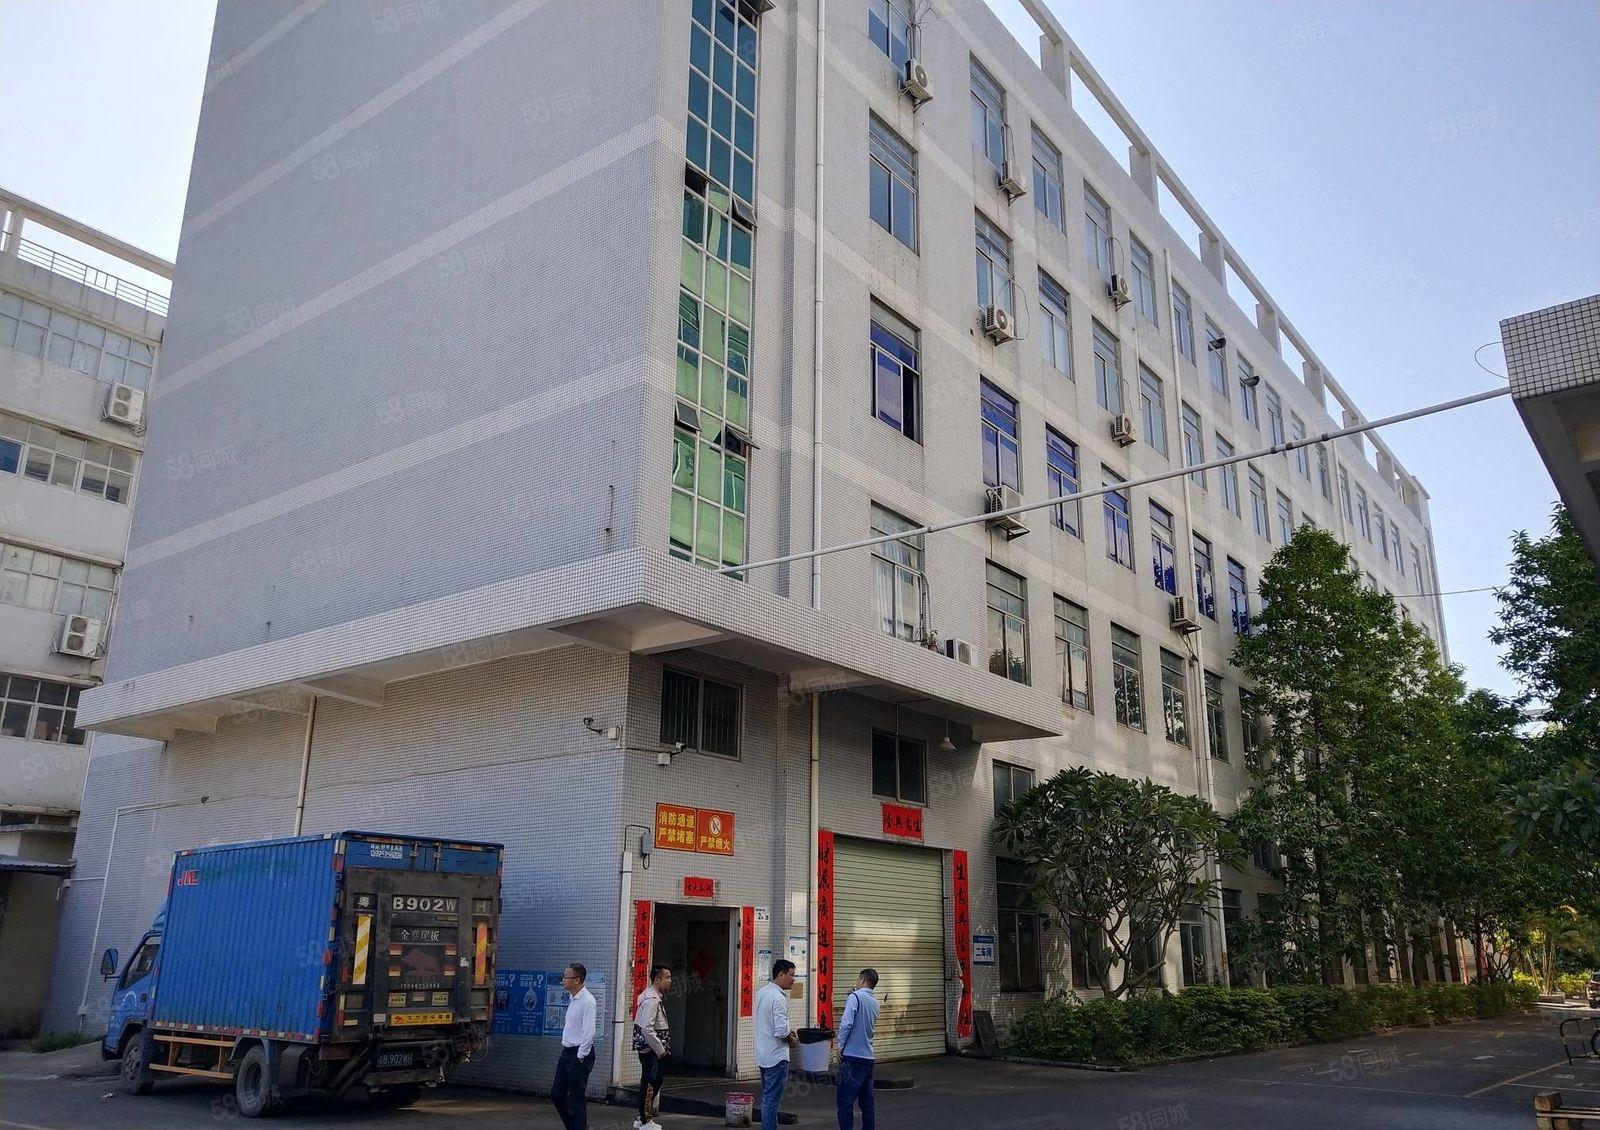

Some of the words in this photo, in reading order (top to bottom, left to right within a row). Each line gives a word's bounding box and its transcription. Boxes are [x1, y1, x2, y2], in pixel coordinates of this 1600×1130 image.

[658, 810, 695, 829] 消防通道
[657, 827, 694, 845] 严禁堵塞
[699, 836, 730, 851] 严禁烟火
[393, 896, 457, 912] B902W
[975, 947, 992, 958] 二车间
